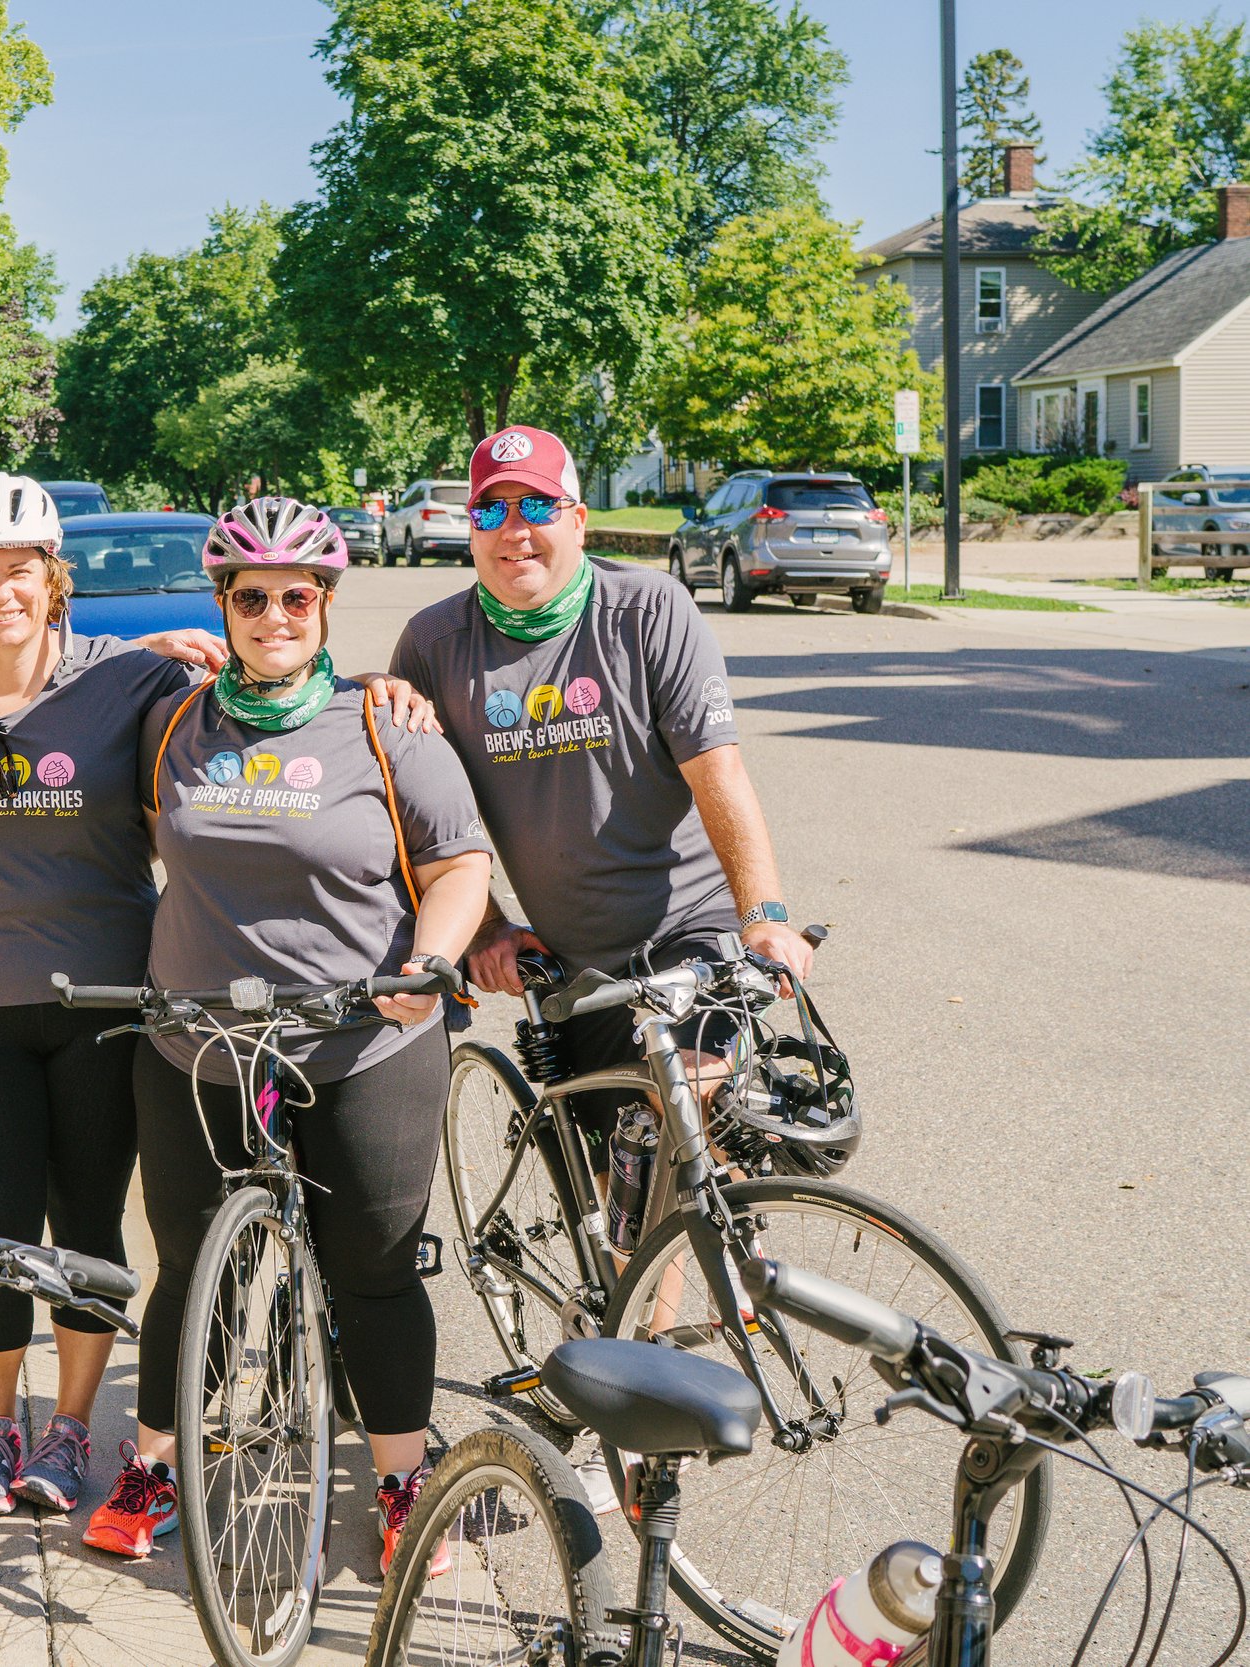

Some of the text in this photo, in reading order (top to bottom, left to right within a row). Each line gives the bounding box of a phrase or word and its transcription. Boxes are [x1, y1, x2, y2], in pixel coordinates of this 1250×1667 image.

[484, 716, 613, 754] BREWS & BAKERIES
[492, 737, 610, 763] small town bike tour
[12, 789, 83, 809] BAKERIES
[191, 785, 321, 810] BREWS & BAKERIES
[24, 808, 48, 817] bike
[54, 808, 79, 817] tour
[189, 803, 313, 820] small town bike tour
[449, 1477, 488, 1509] BONTRAGER
